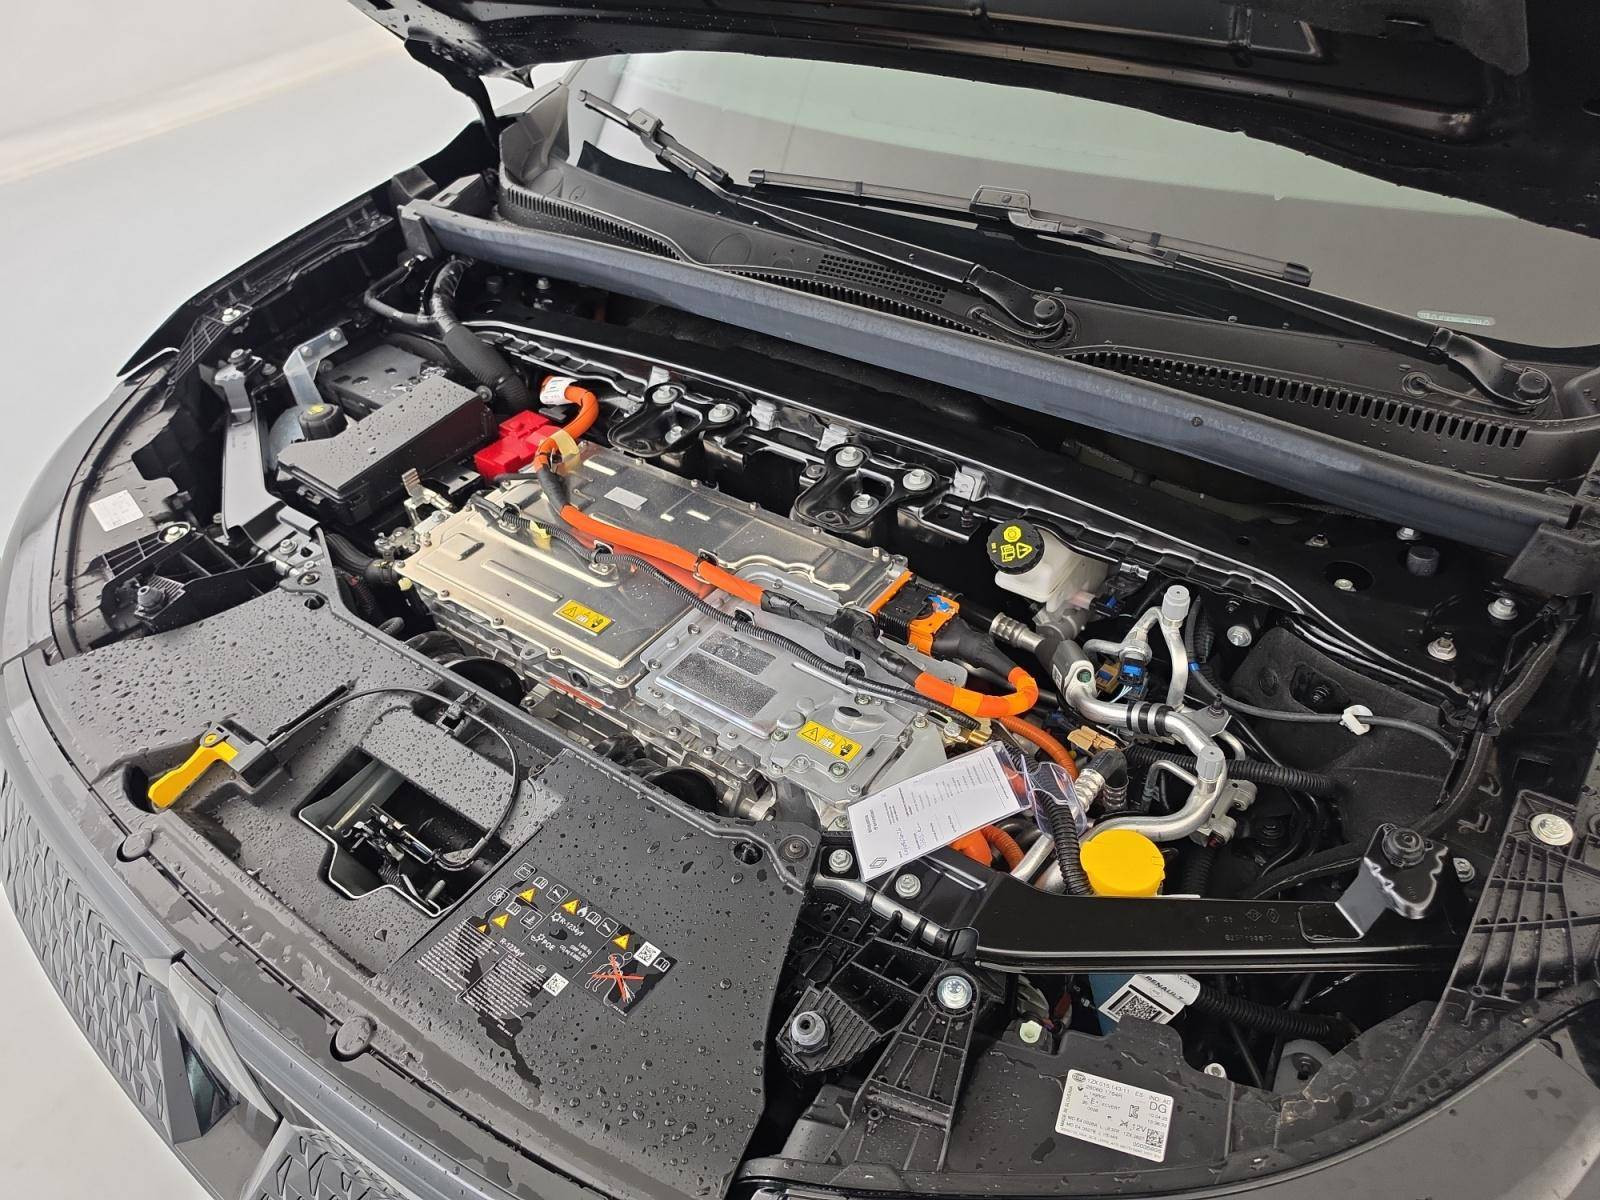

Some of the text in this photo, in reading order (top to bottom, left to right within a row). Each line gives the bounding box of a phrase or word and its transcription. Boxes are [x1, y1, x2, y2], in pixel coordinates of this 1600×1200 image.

[559, 917, 585, 937] R-1234yf
[541, 938, 556, 951] POE
[1144, 975, 1184, 1000] RENAULT
[1149, 1101, 1167, 1114] DG
